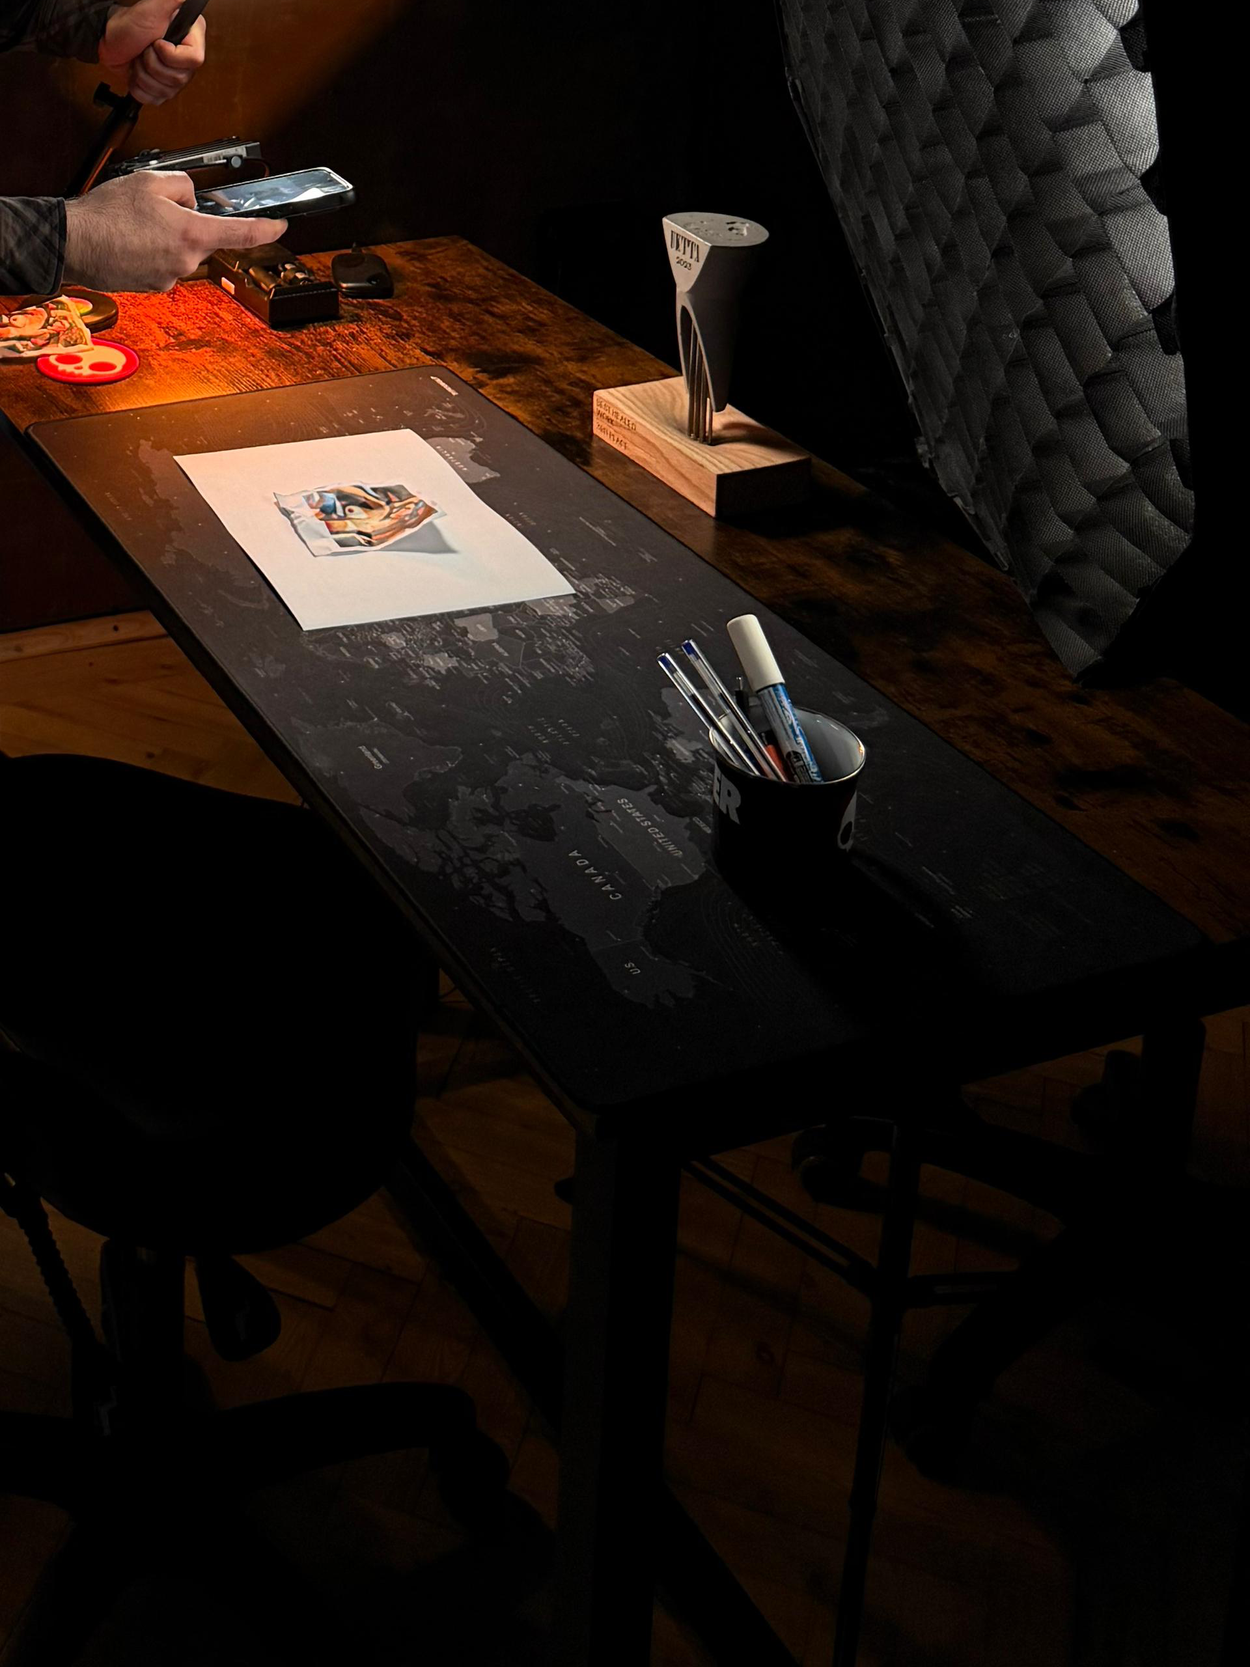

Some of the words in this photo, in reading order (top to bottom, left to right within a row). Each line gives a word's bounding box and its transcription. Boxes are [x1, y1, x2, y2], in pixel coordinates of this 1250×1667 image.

[617, 797, 652, 827] STATES
[648, 826, 684, 858] UNITED
[568, 849, 622, 900] CANADA
[624, 961, 642, 975] US
